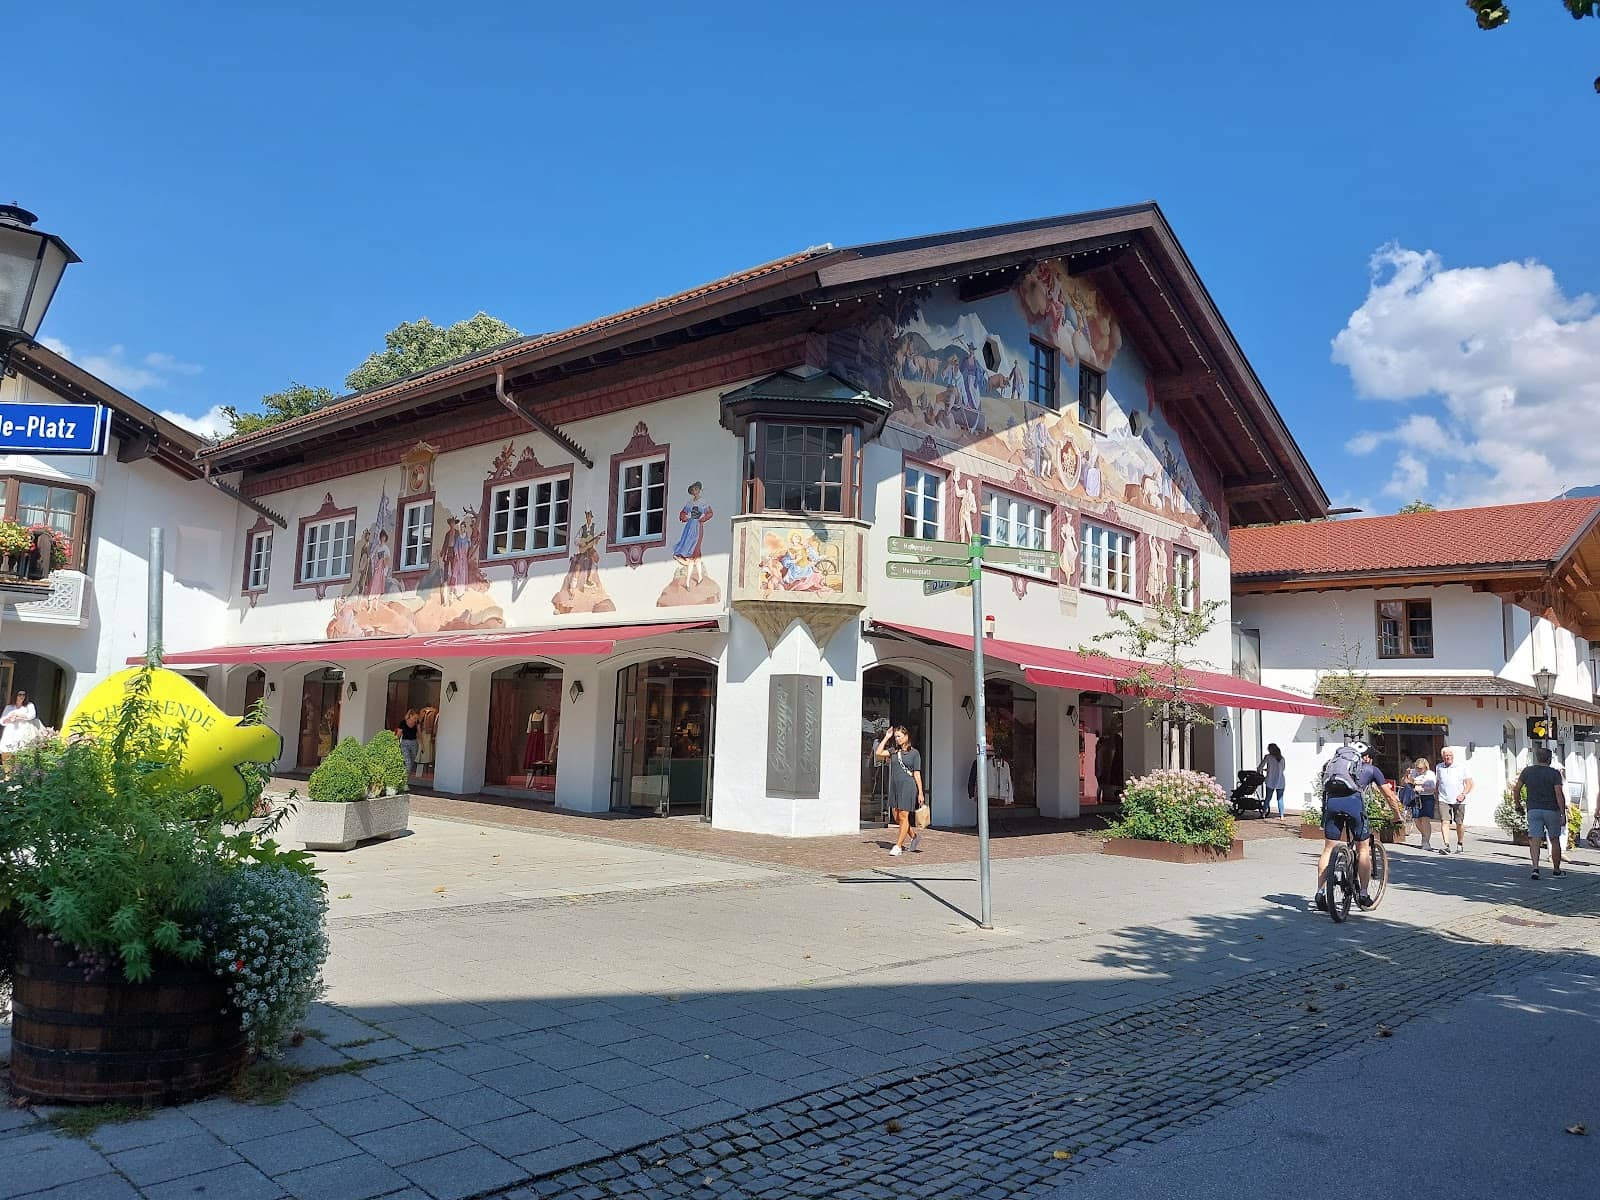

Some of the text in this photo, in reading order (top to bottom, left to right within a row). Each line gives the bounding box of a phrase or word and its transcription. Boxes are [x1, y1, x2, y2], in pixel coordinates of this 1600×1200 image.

[0, 415, 77, 439] e-Platz
[162, 700, 215, 732] ENDE
[1393, 714, 1447, 725] Wolfskin
